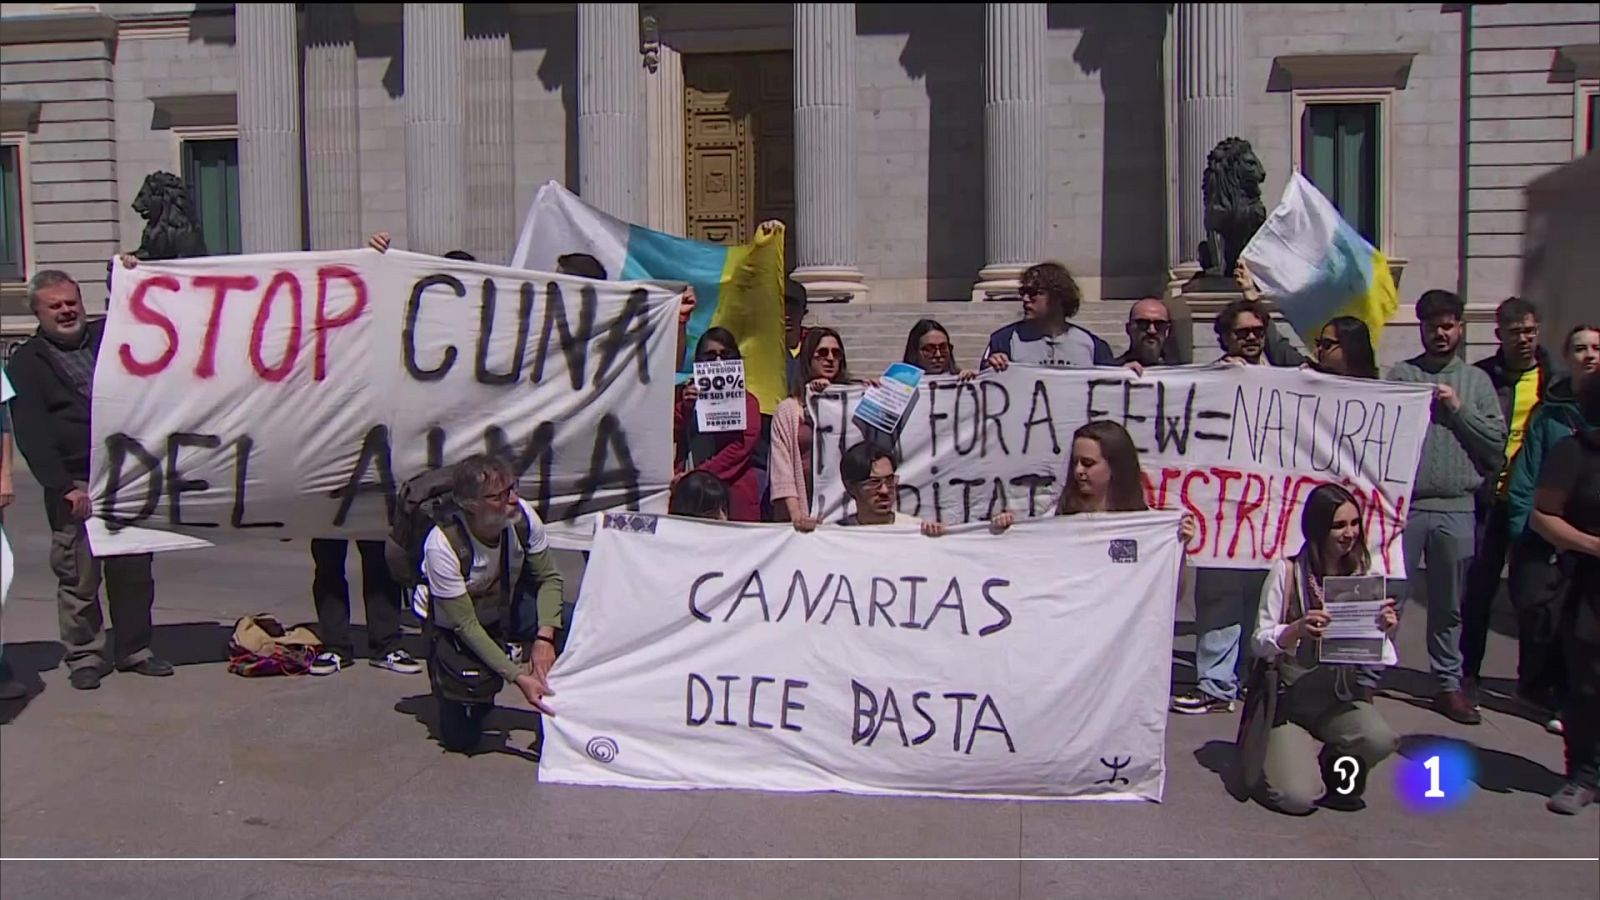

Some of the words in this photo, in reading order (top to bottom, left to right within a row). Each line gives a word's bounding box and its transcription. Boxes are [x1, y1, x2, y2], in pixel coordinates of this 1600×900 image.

[119, 264, 368, 383] STOP
[402, 273, 651, 391] CUNA
[698, 374, 744, 391] 90%
[929, 379, 1010, 459] FOR
[1022, 379, 1061, 455] A
[104, 431, 285, 534] DEL
[688, 568, 1013, 637] CANARIAS
[685, 672, 809, 732] DICE
[850, 677, 1018, 755] BASTA
